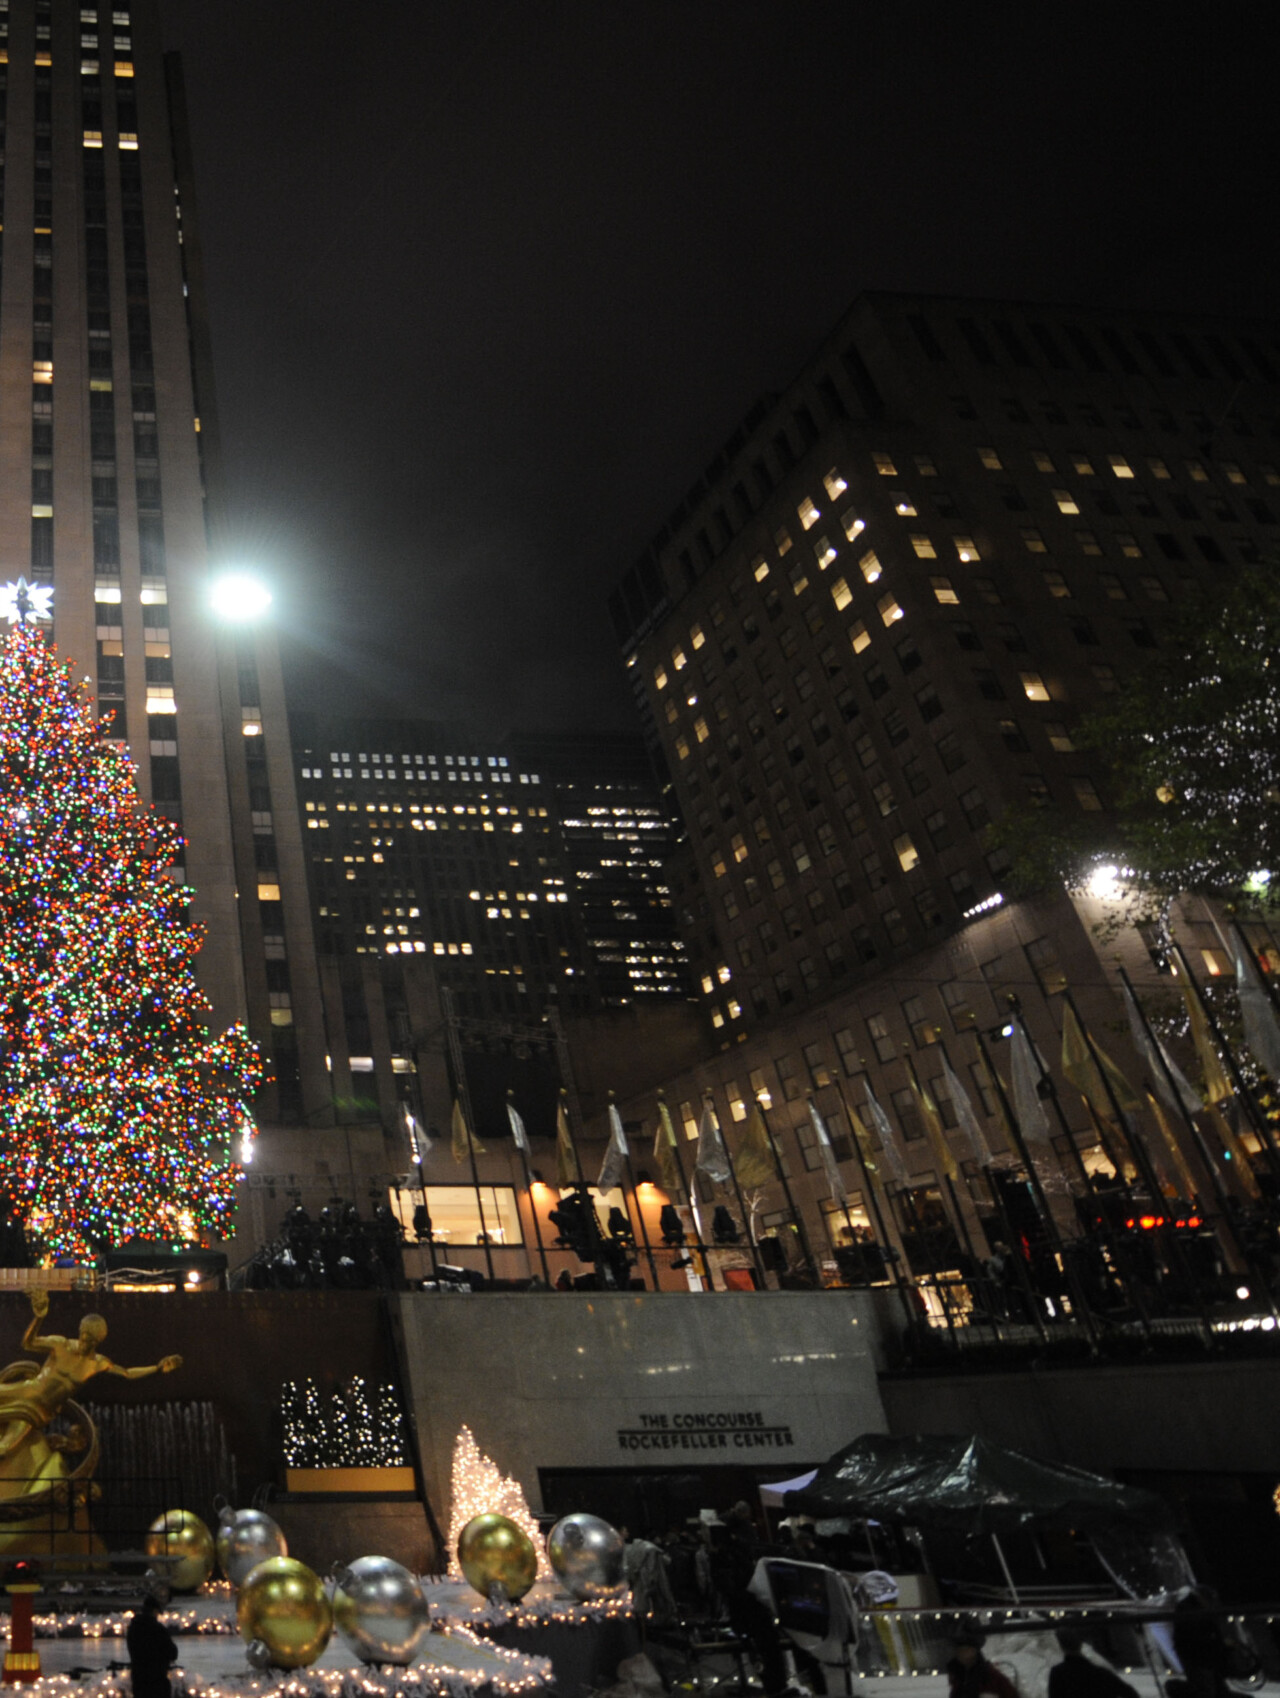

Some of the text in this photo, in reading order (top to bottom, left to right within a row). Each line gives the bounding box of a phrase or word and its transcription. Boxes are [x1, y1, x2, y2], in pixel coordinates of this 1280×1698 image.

[639, 1412, 765, 1429] THE CONCOURSE
[618, 1432, 795, 1450] ROCKEFELLER CENTER
